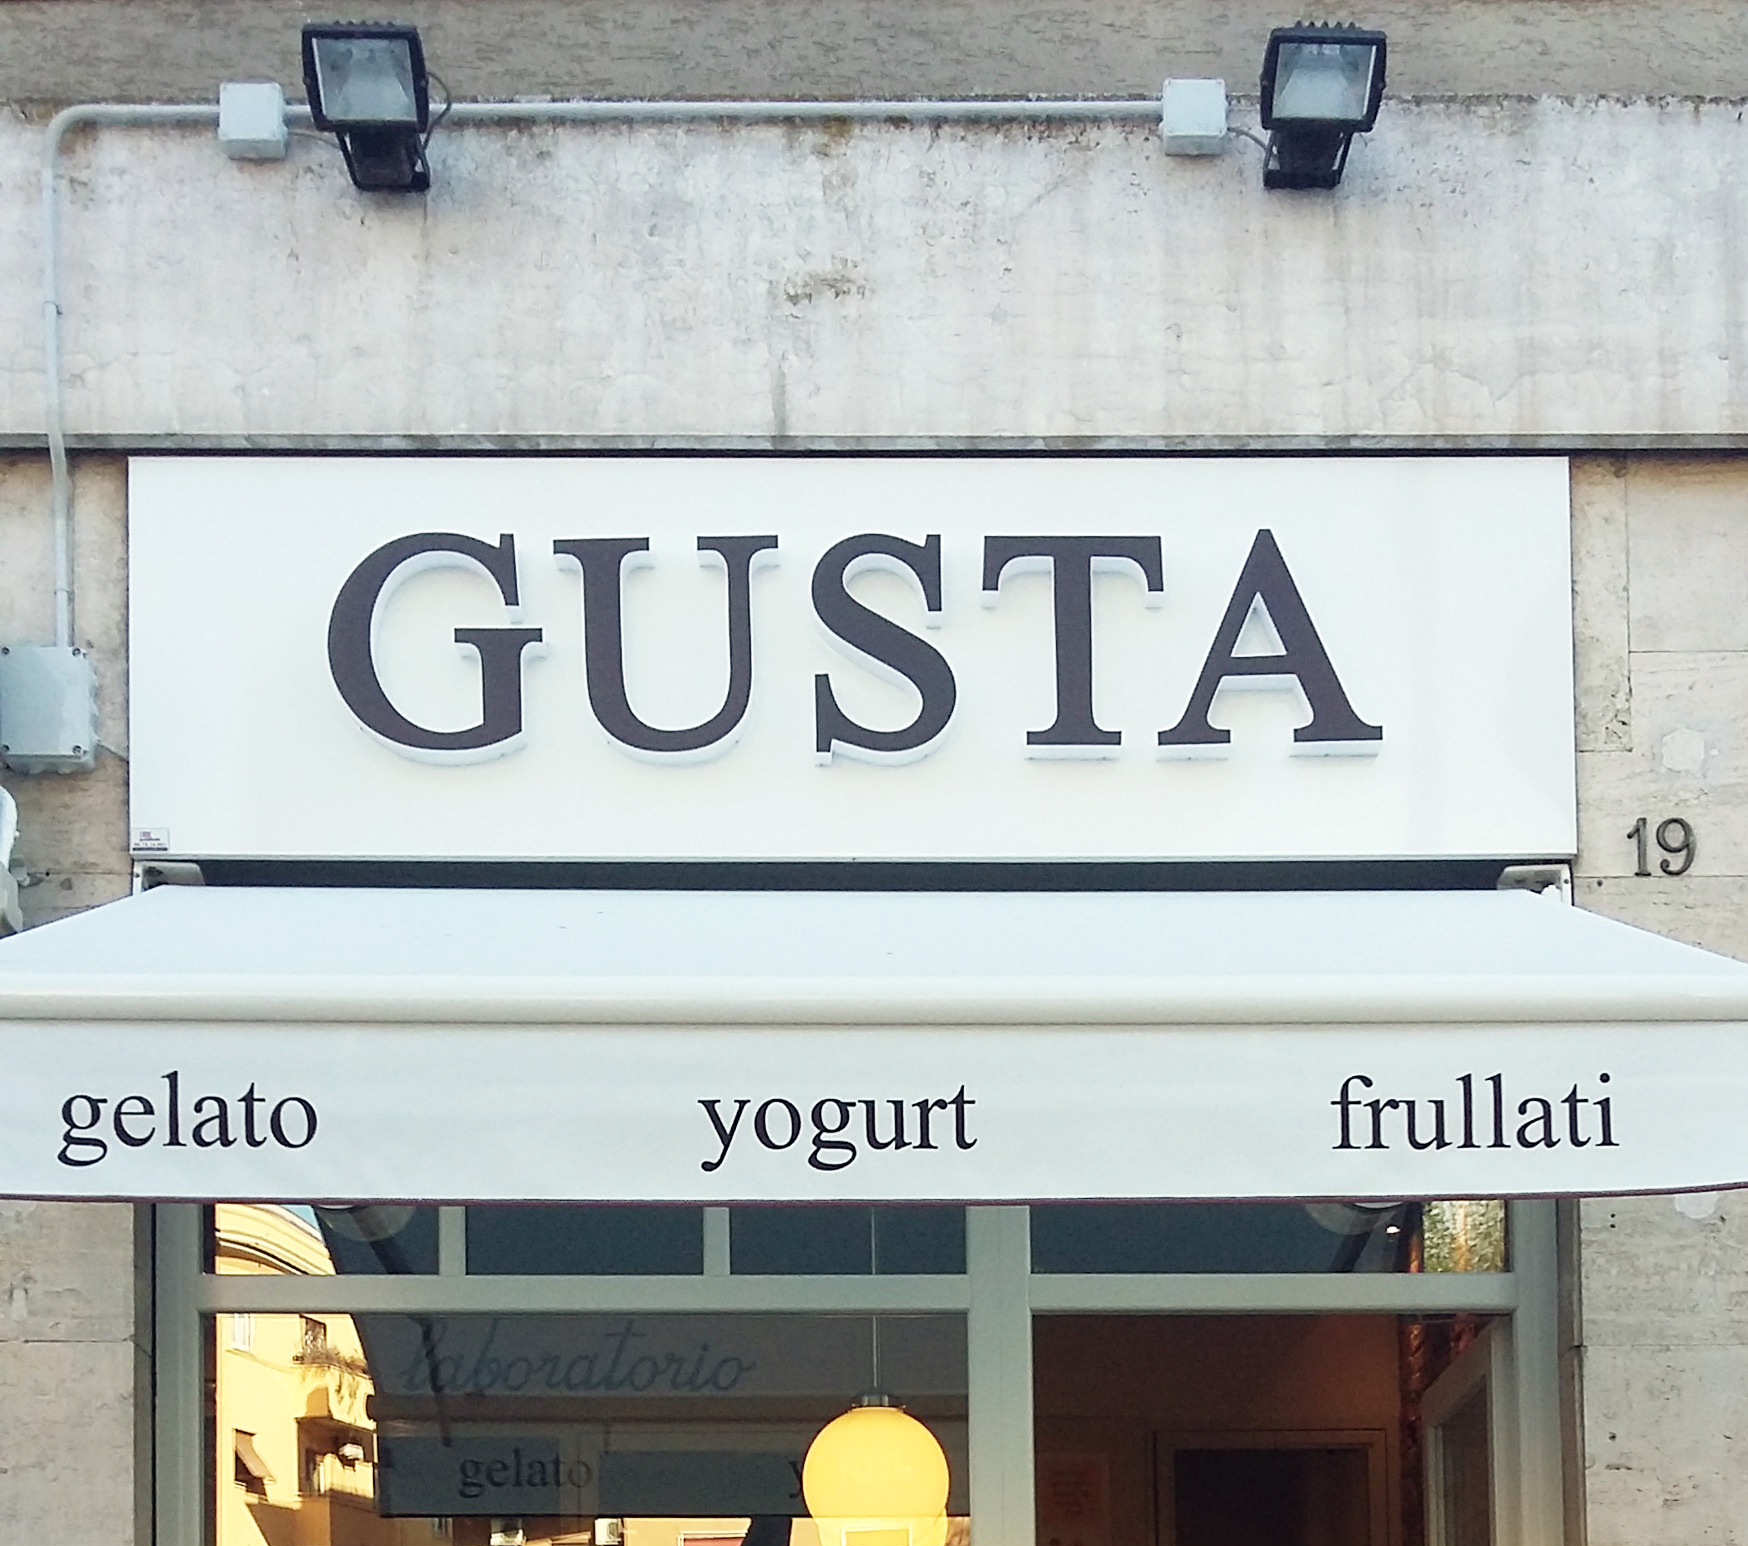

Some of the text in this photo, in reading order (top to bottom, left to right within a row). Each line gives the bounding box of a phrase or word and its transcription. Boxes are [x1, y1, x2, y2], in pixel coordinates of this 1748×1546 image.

[327, 528, 1384, 755] GUSTA
[1626, 817, 1695, 878] 19
[58, 1070, 318, 1167] gelato
[697, 1084, 978, 1172] yogurt
[1330, 1072, 1620, 1151] frullati
[401, 1316, 756, 1392] laboratorio
[459, 1447, 593, 1498] gelato
